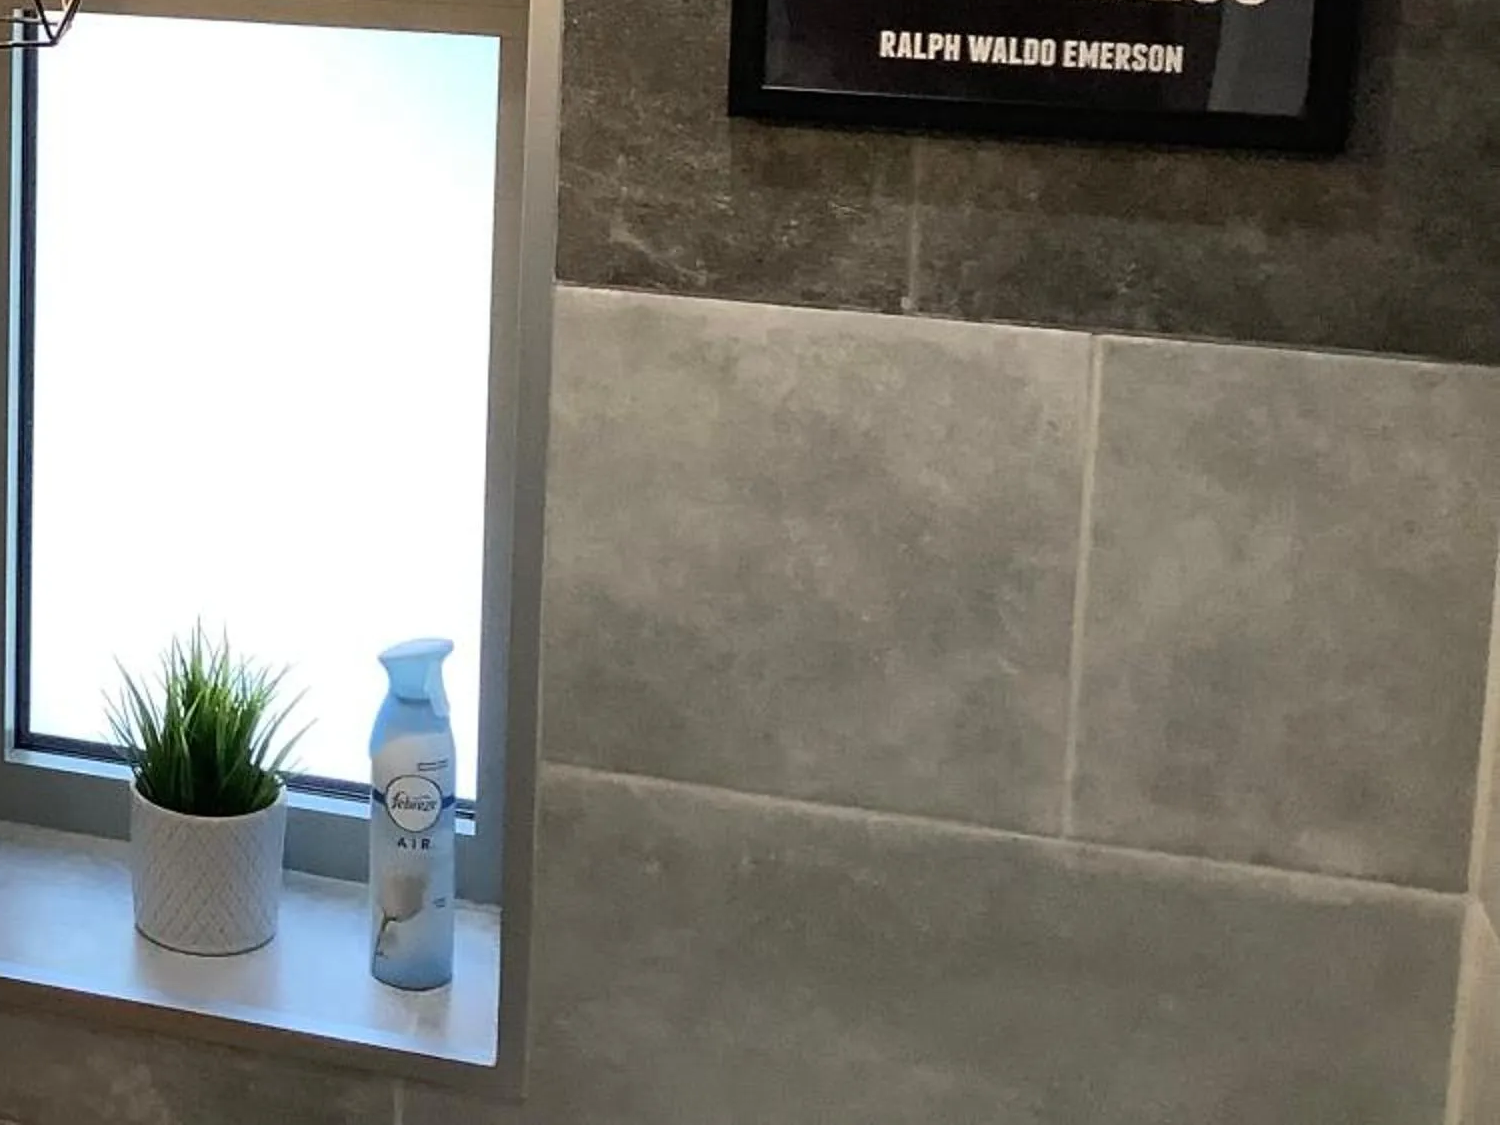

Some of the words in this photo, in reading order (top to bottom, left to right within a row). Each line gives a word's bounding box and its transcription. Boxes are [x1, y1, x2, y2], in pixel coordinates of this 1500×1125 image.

[879, 30, 961, 62] RALPH
[968, 35, 1056, 68] WALDO
[1063, 40, 1184, 74] EMERSON
[397, 837, 431, 850] AIR
